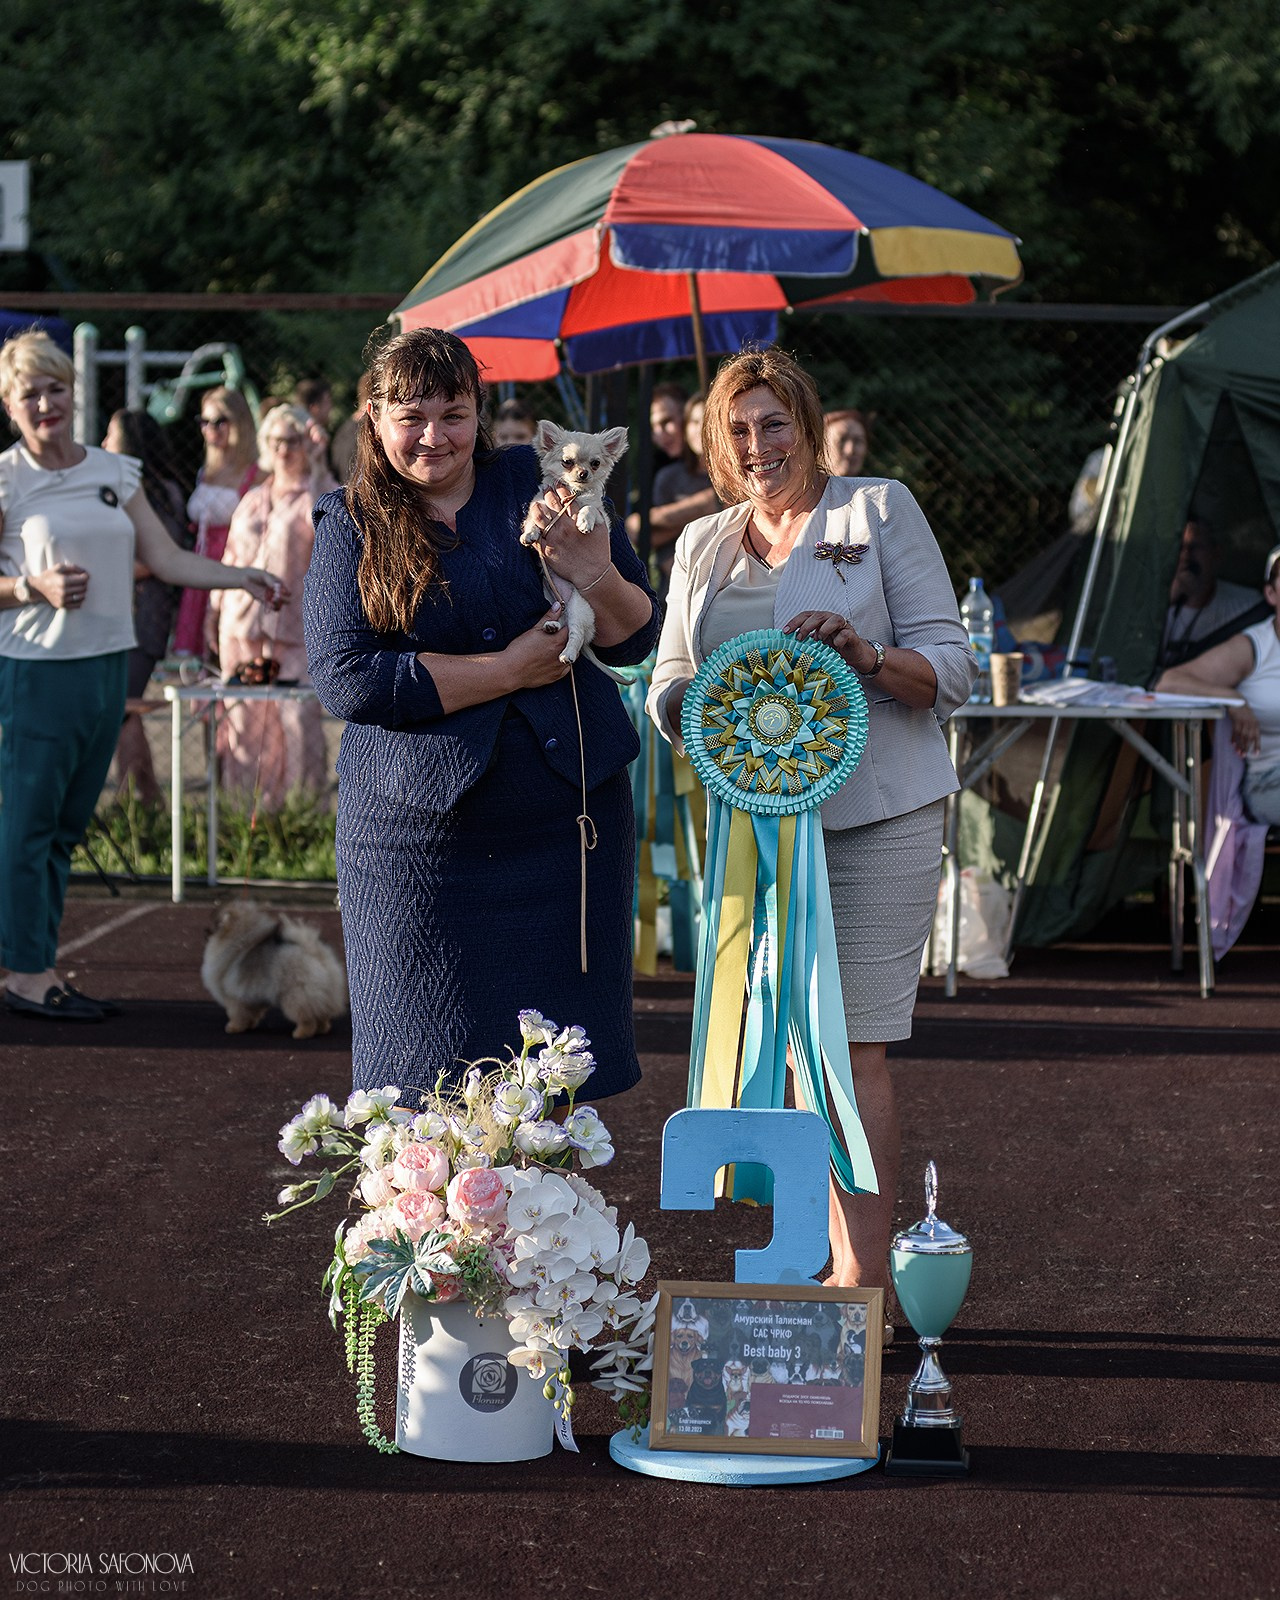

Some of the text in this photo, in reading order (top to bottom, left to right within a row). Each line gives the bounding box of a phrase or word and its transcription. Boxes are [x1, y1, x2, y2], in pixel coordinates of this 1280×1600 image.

[734, 1313, 813, 1326] Амурский Талисман
[770, 1328, 793, 1339] ЧРКФ
[743, 1343, 801, 1361] Best baby 3
